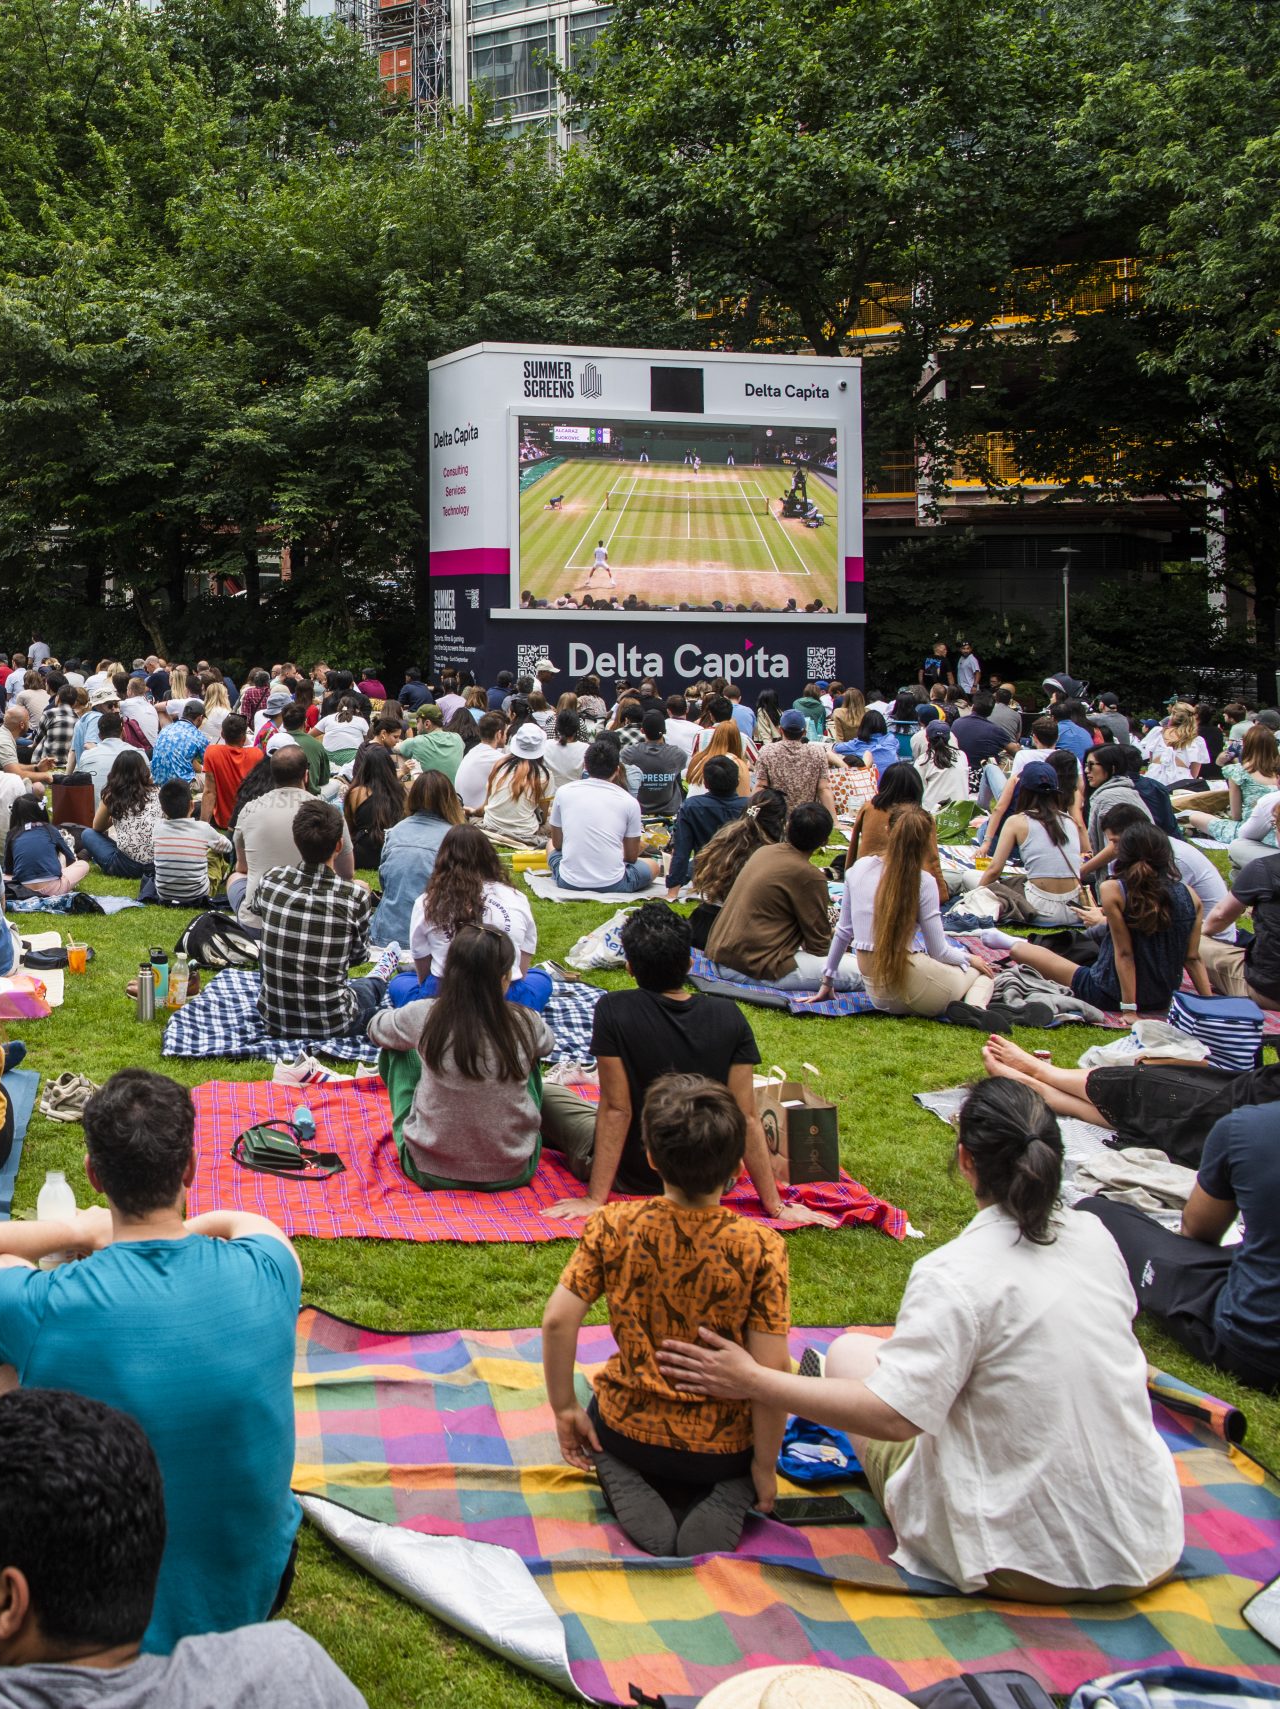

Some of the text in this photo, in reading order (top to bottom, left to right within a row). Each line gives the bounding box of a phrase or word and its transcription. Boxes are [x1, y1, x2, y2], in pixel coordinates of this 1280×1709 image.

[524, 361, 571, 379] SUMMER
[524, 380, 574, 398] SCREENS
[745, 383, 829, 401] Delta Capita
[434, 422, 478, 448] Delta Capita
[443, 464, 468, 478] Consulting
[446, 485, 466, 497] Services
[443, 505, 469, 516] Technology
[434, 590, 455, 609] SUMMER
[434, 610, 456, 630] SCREENS
[569, 638, 789, 684] Delta Capita
[488, 899, 511, 922] SURPRISE
